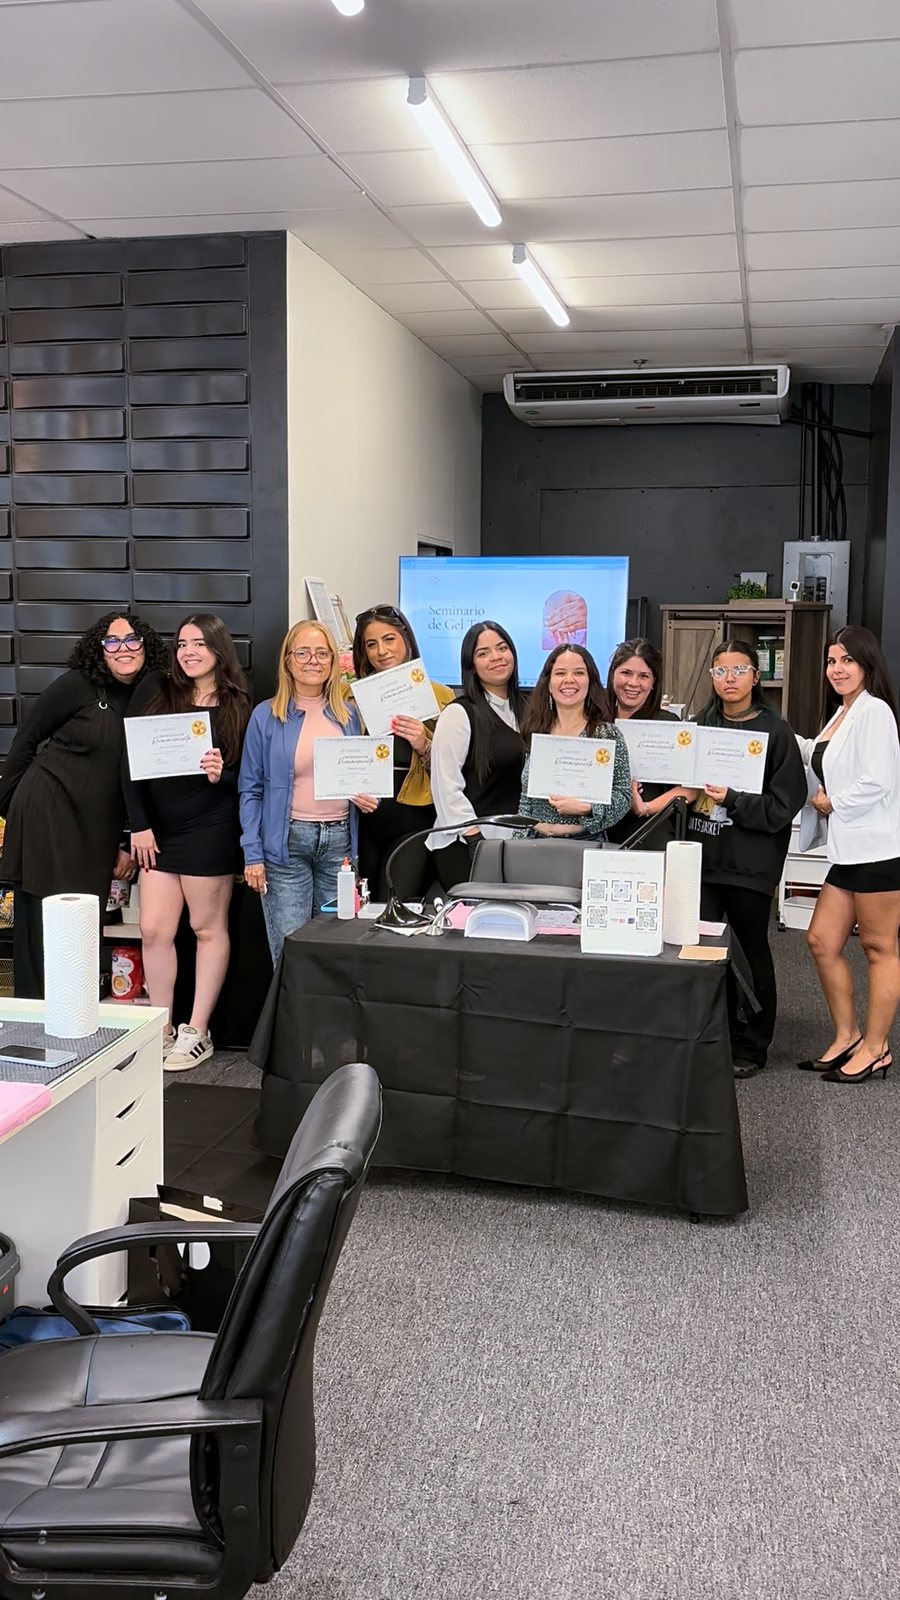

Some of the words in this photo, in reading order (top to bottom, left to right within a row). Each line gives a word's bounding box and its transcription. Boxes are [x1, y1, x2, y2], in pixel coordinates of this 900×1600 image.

[428, 605, 485, 616] Seminario
[428, 618, 442, 630] de
[444, 618, 464, 630] Gel
